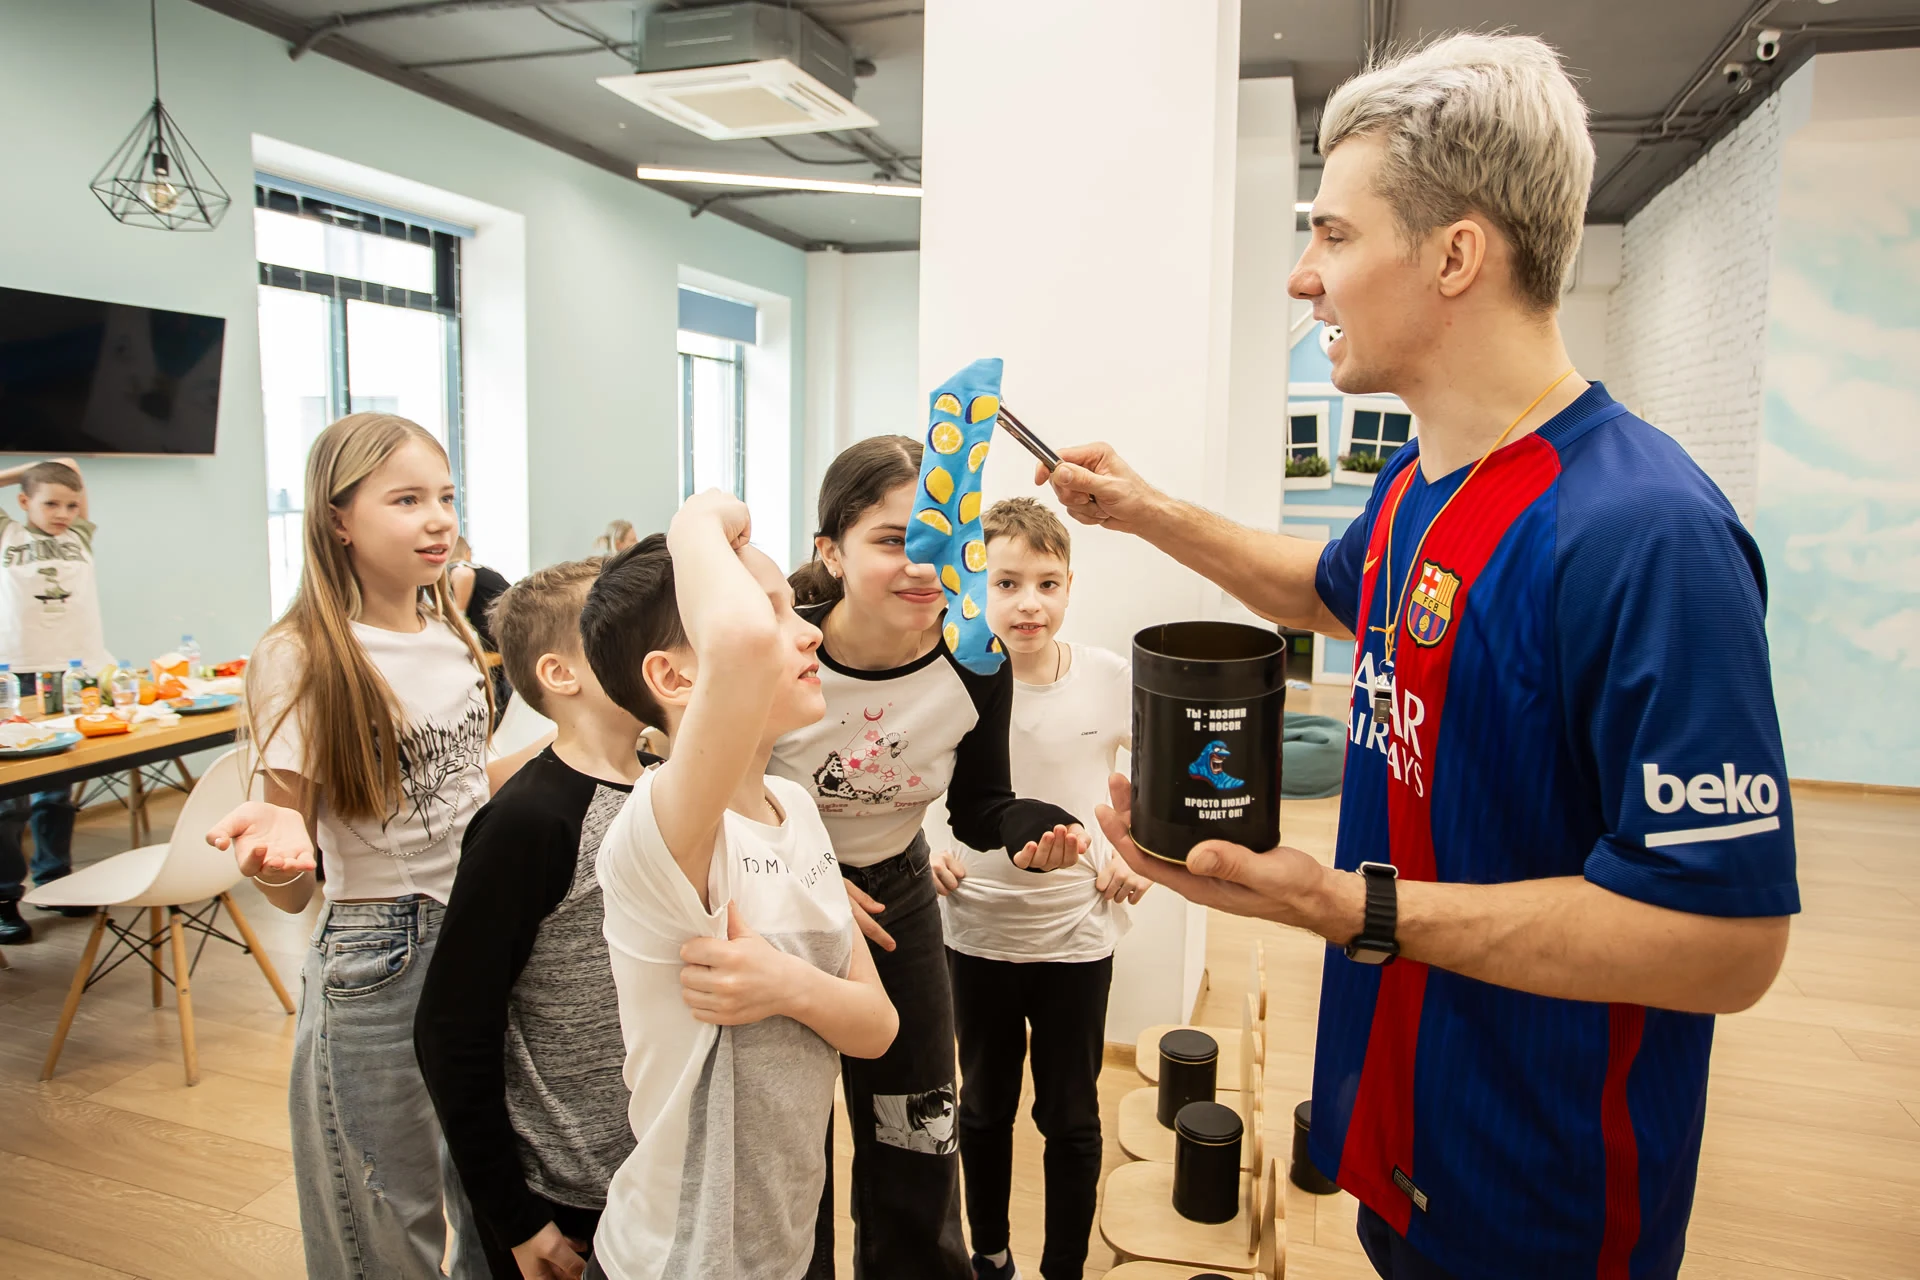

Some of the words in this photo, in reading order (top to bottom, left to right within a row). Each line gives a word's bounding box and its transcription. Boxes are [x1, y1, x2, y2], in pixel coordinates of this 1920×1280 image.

[1423, 596, 1439, 612] FCB
[1185, 708, 1201, 719] ТЫ
[1209, 720, 1241, 731] НОСОК
[1642, 763, 1780, 814] beko
[1184, 797, 1220, 808] ПРОСТО
[1199, 809, 1227, 820] БУДЕТ
